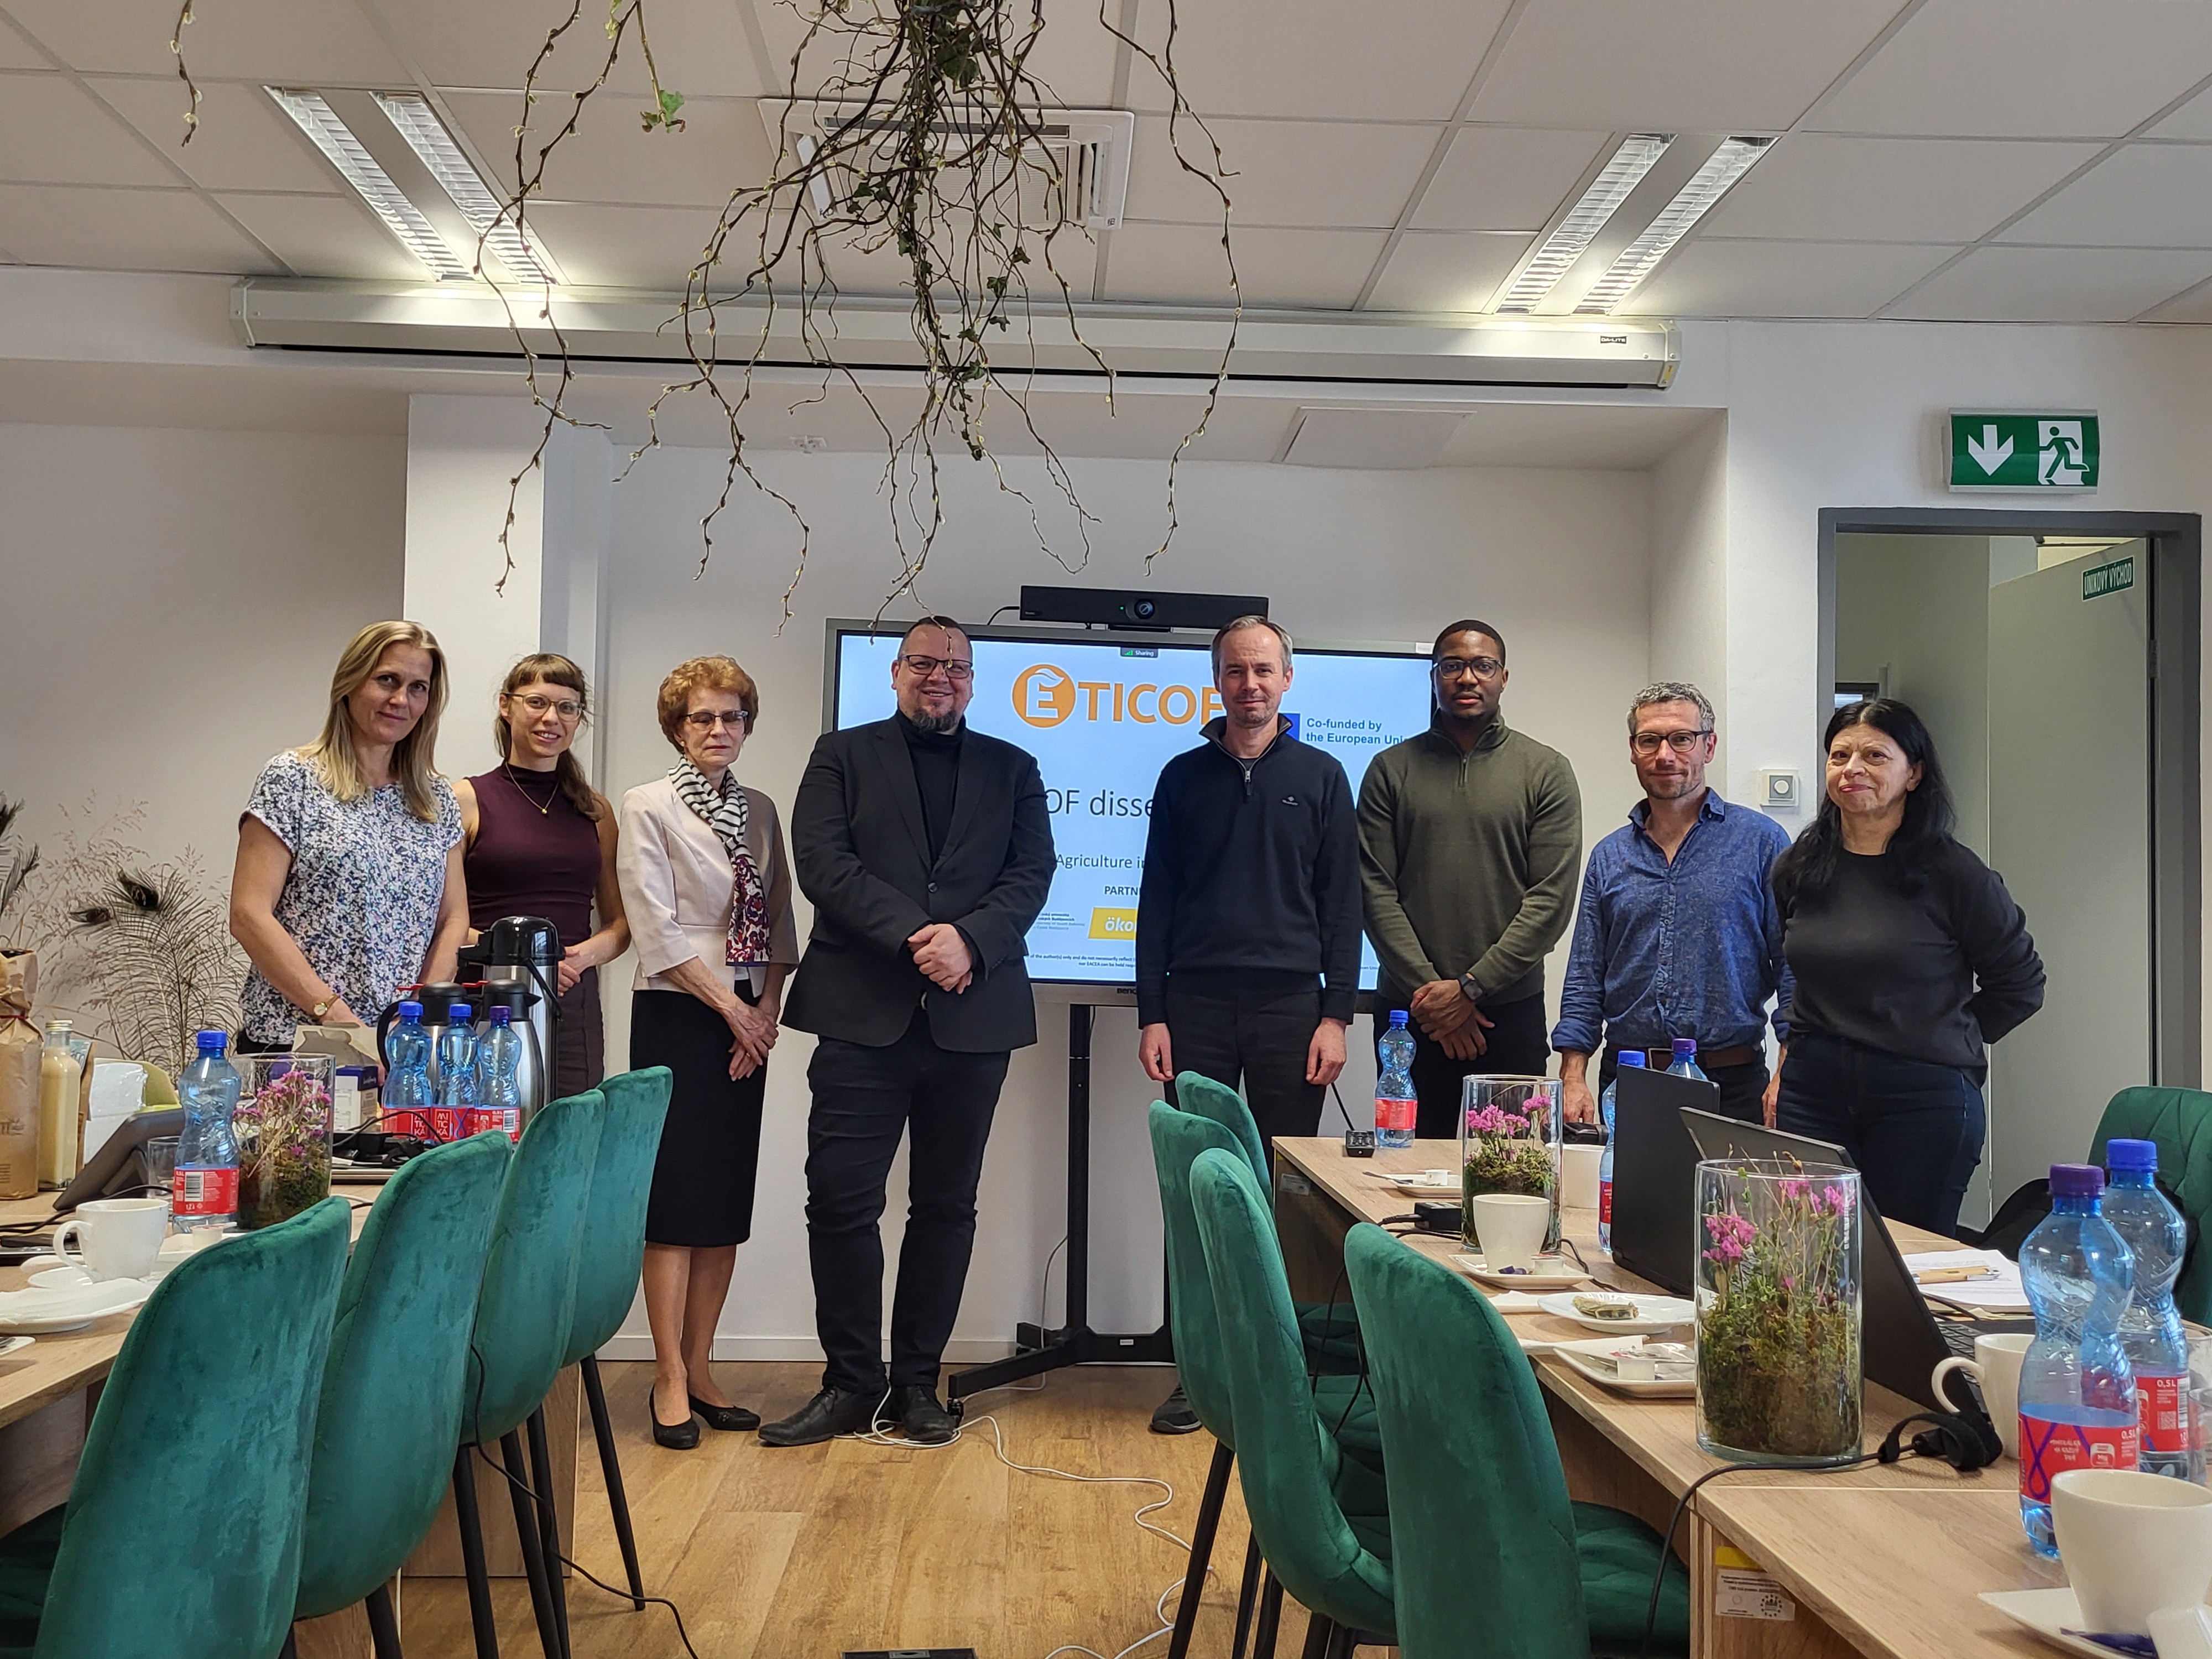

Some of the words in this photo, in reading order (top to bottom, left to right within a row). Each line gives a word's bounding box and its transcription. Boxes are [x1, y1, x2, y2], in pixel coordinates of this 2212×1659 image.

[2084, 566, 2108, 596] ÚNIKOVÝ
[2109, 563, 2132, 588] VÝCHOD
[1307, 718, 1365, 729] Co-funded
[1368, 720, 1382, 732] by
[1306, 732, 1324, 742] the
[1327, 733, 1381, 745] European
[1385, 734, 1408, 745] Uni
[1057, 854, 1133, 869] Agriculture
[1105, 917, 1134, 932] öko
[437, 1120, 448, 1129] TIC
